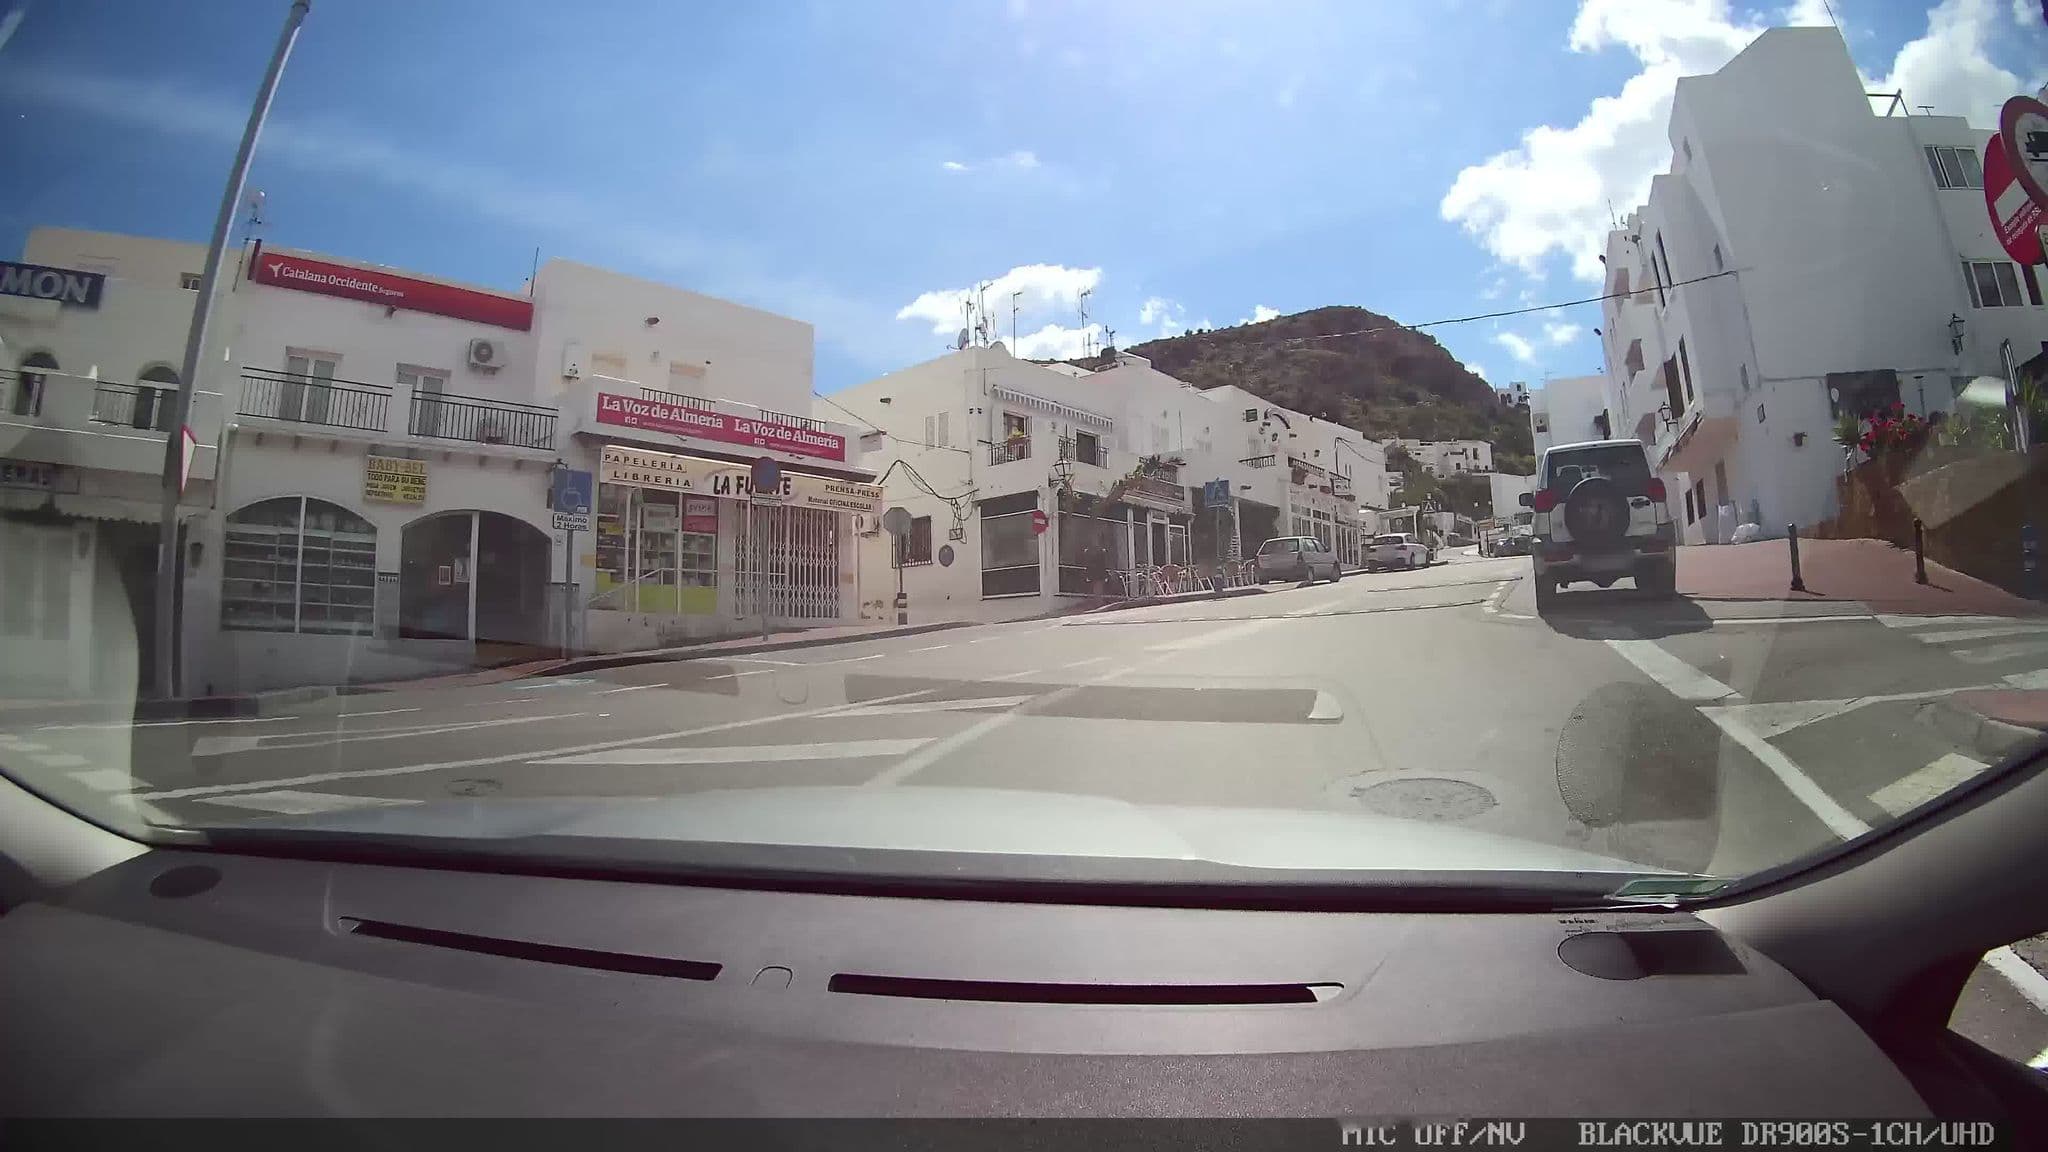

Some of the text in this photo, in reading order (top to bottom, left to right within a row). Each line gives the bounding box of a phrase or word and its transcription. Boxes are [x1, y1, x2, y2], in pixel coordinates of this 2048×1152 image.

[282, 266, 327, 284] Catalana
[328, 274, 379, 294] Occidente
[602, 396, 621, 412] La
[622, 399, 650, 416] Voz
[650, 404, 669, 419] de
[669, 407, 724, 429] Almería
[734, 418, 751, 433] La
[751, 421, 776, 438] Voz
[776, 426, 792, 441] de
[792, 429, 840, 449] Almería
[713, 475, 730, 495] LA
